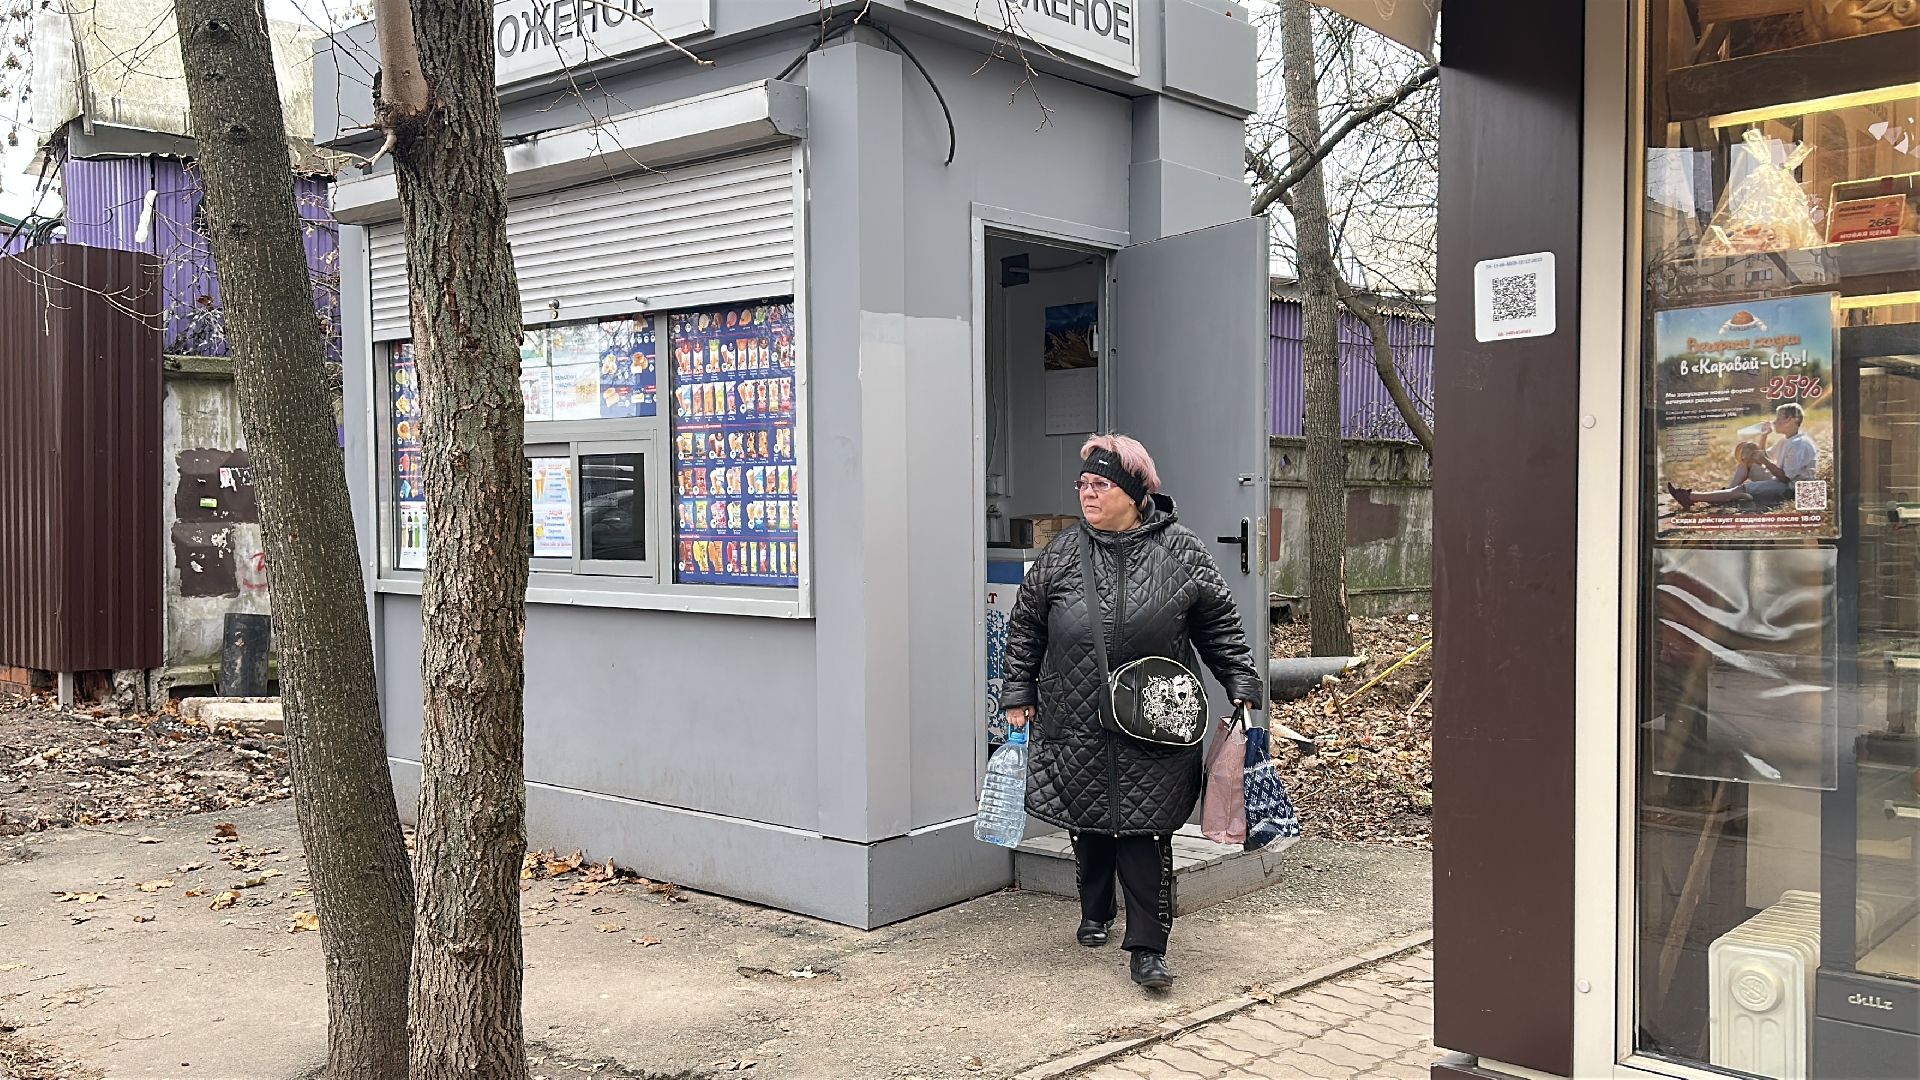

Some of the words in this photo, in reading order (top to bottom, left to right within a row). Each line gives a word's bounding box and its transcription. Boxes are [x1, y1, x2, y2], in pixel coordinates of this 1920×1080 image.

[1680, 360, 1689, 376] в
[1759, 375, 1823, 400] -25%
[1698, 516, 1733, 524] действует
